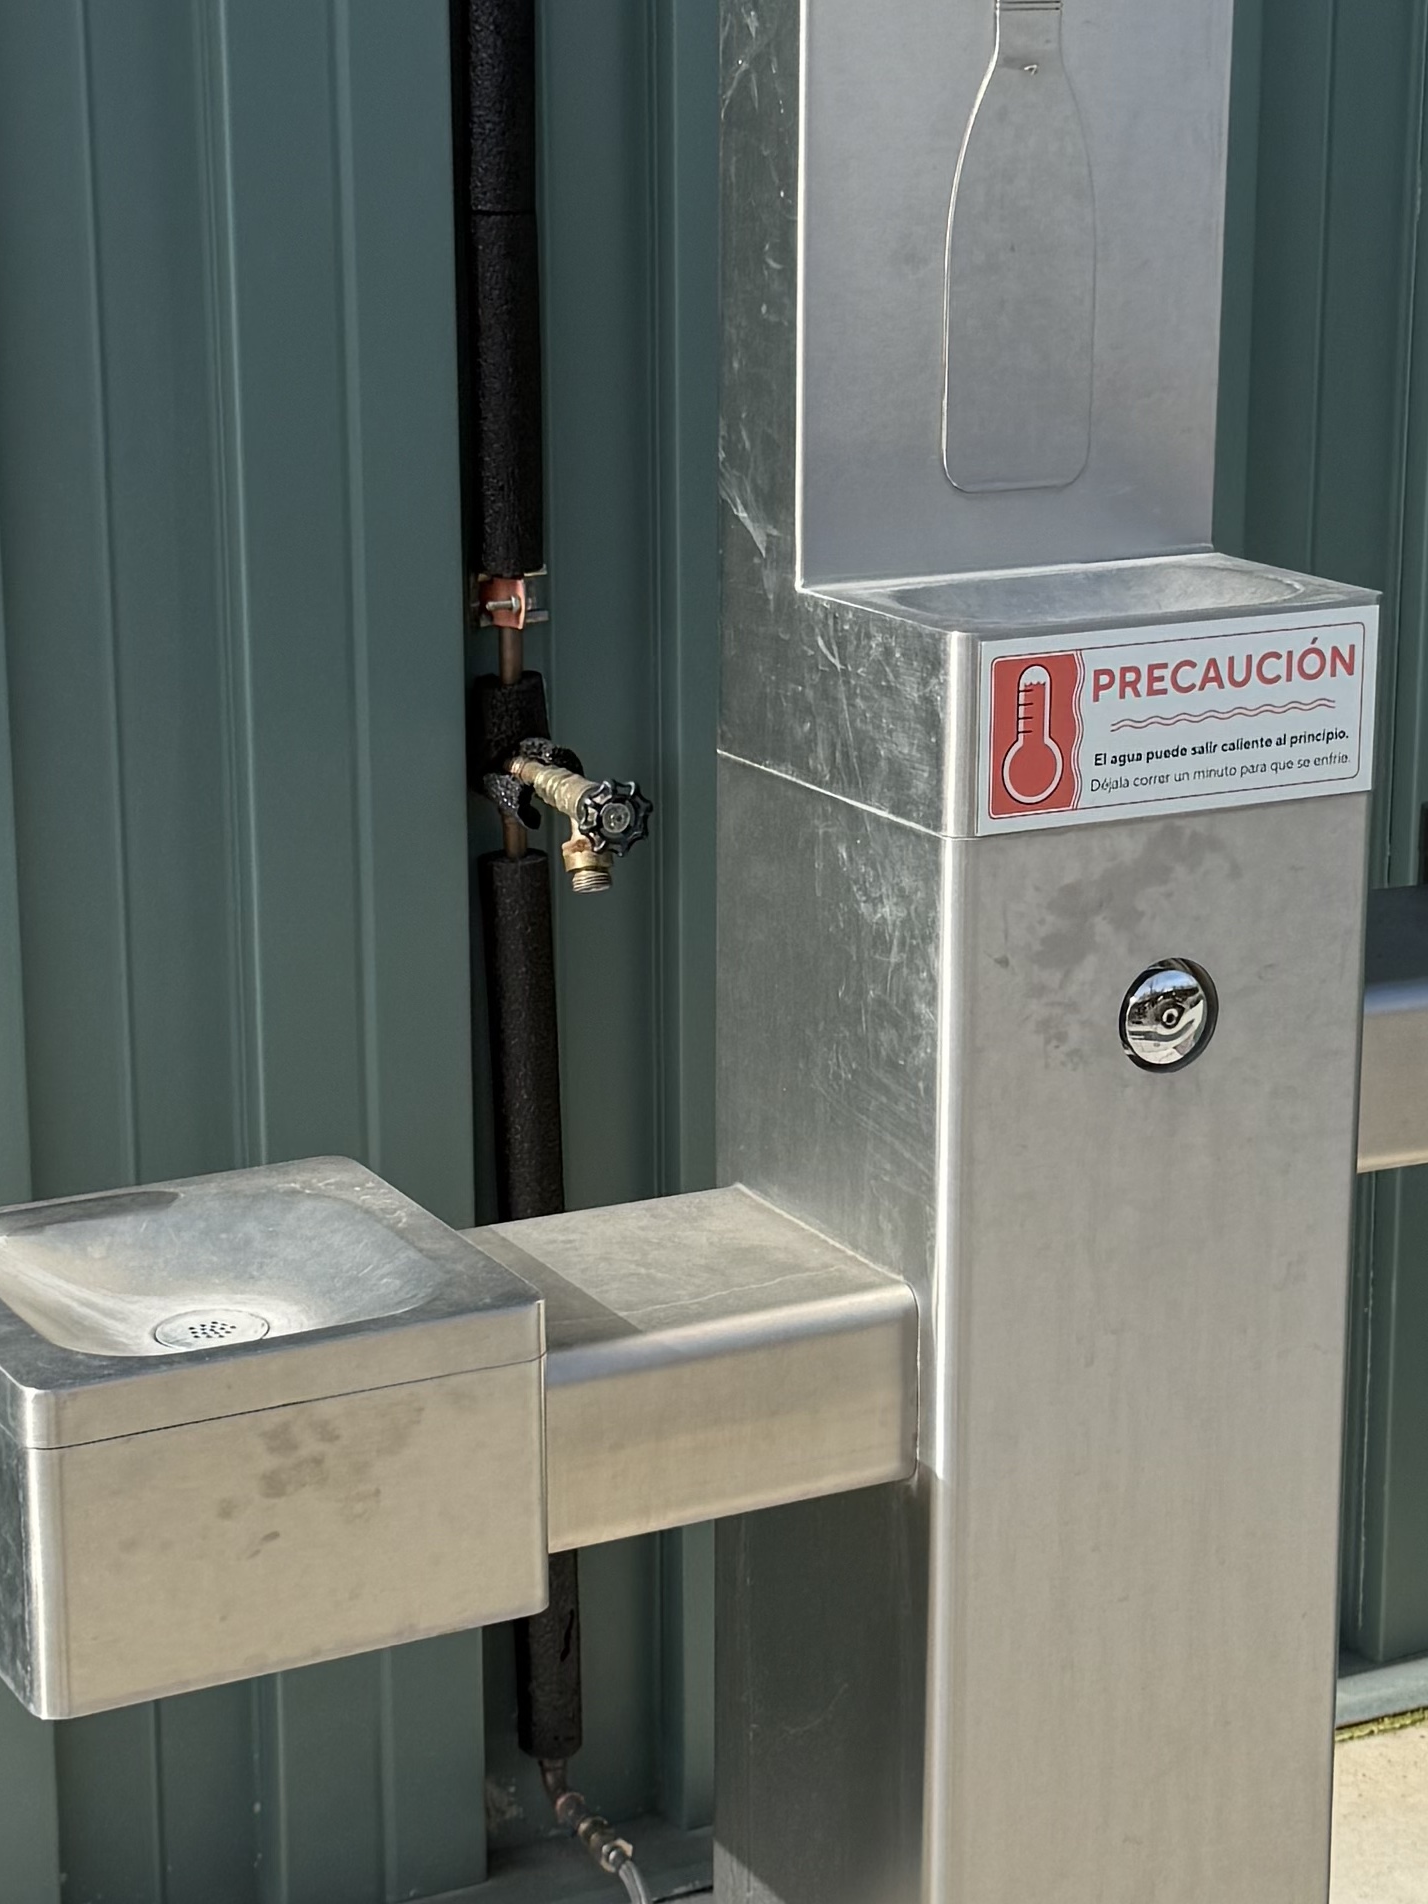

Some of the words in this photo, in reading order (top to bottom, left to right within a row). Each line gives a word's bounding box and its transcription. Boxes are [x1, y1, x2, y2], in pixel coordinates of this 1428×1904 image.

[1091, 637, 1356, 703] PRECAUCIÓN
[1094, 753, 1107, 766] El
[1110, 752, 1143, 767] agua
[1146, 745, 1187, 764] puede
[1191, 741, 1218, 756] salir
[1221, 736, 1273, 753] caliente
[1275, 733, 1287, 747] al
[1290, 727, 1349, 748] principio.
[1133, 774, 1171, 787] correr
[1174, 772, 1190, 783] un
[1193, 765, 1237, 780] minuto
[1240, 763, 1267, 778] para
[1270, 760, 1294, 775] que
[1297, 758, 1311, 769] se
